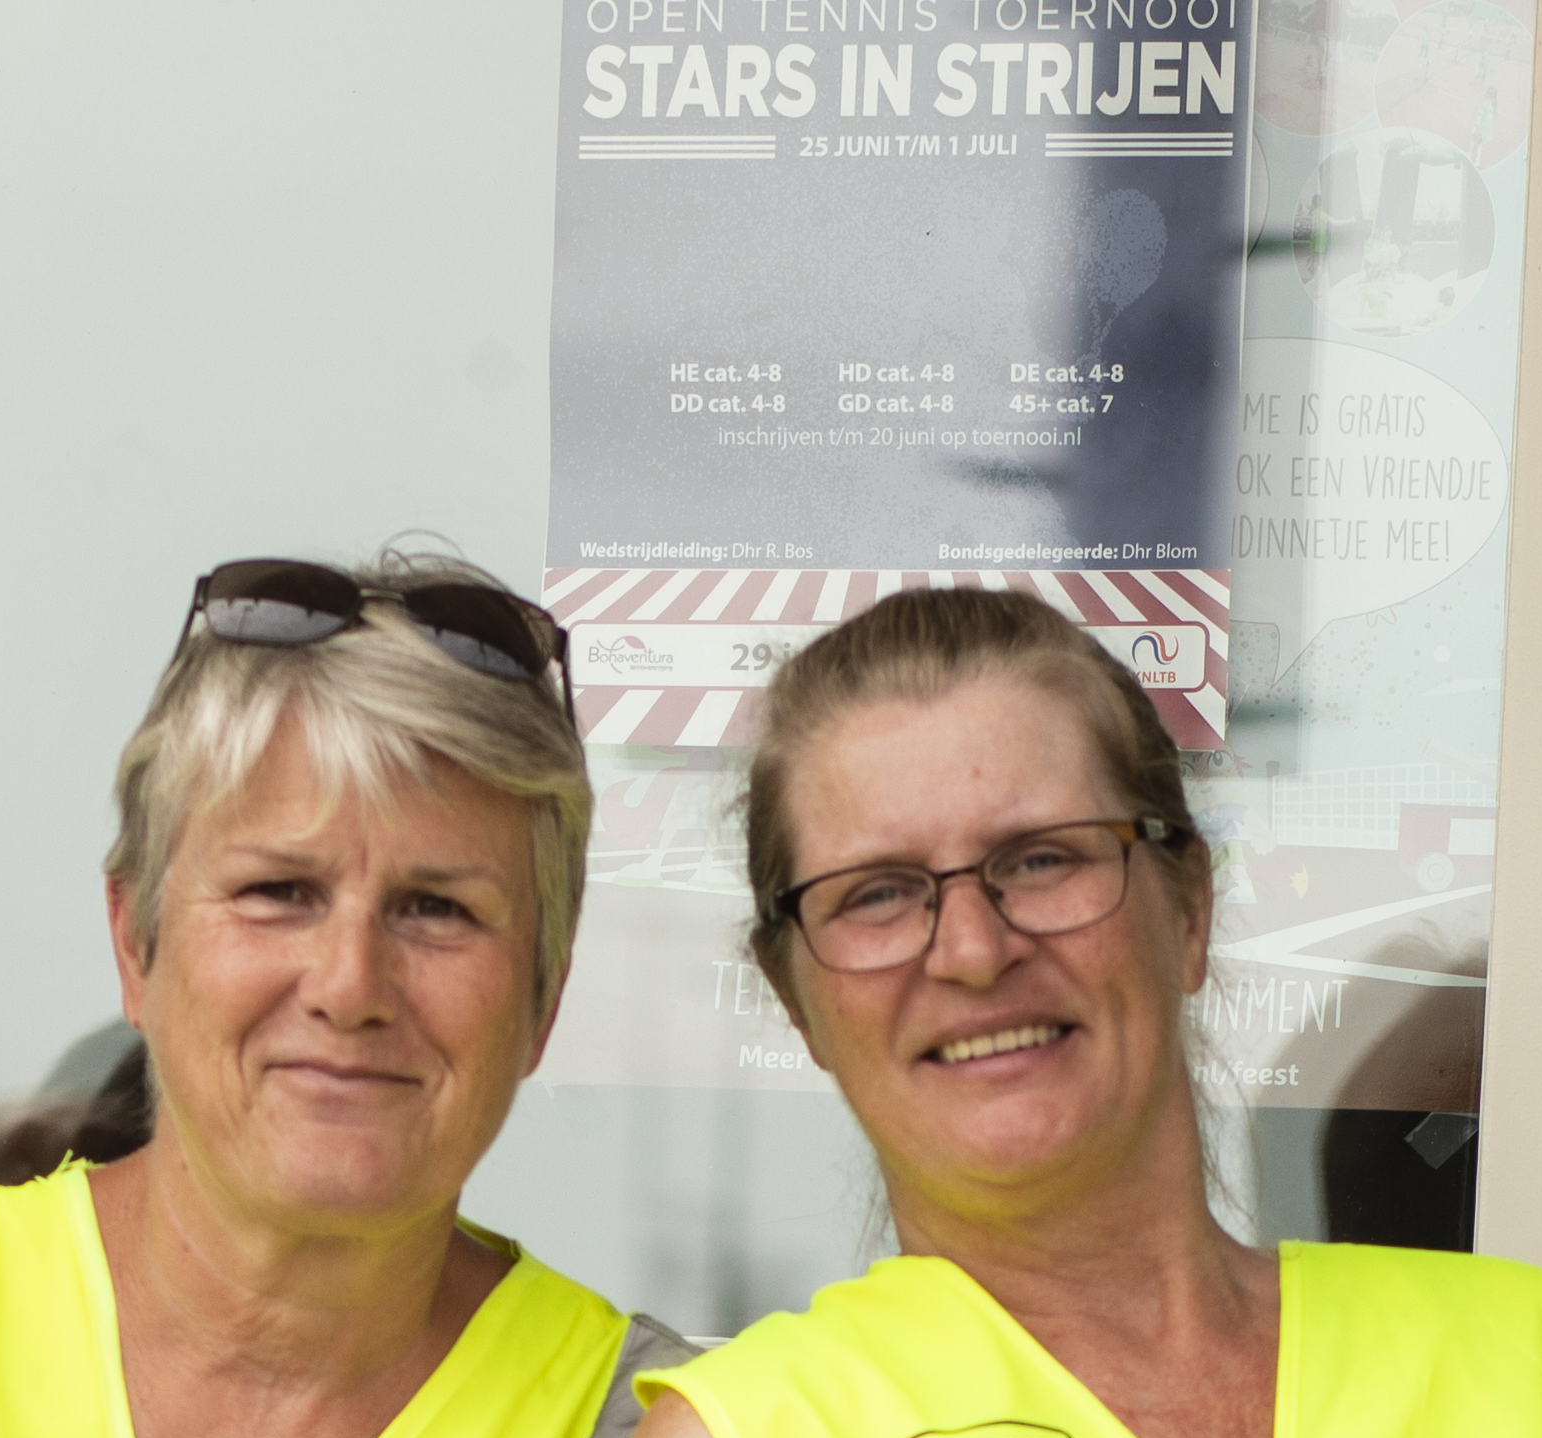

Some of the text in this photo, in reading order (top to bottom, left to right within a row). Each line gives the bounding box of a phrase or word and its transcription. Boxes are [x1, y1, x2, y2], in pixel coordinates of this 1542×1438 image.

[587, 0, 1235, 33] OPEN TENNIS TOERNOOI
[583, 41, 1235, 119] STARS IN STRIJEN
[799, 135, 1018, 157] 25 JUNI T/M 1 JULI
[670, 363, 782, 383] HE cat. 4-8
[838, 363, 955, 383] HD cat. 4-8
[1010, 363, 1124, 383] DE cat. 4-8
[670, 394, 786, 413] DD cat. 4-8
[838, 394, 954, 413] GD cat. 4-8
[1009, 394, 1114, 413] 45+ cat. 7
[1298, 393, 1320, 436] IS
[1338, 393, 1426, 437] GRATIS
[718, 426, 1082, 451] inschrijven t/m 20 juni op toernooi.nl
[1290, 456, 1345, 497] EEN
[1364, 455, 1492, 501] VRIENDJE
[1231, 514, 1451, 562] DINNETJE MEE!
[580, 542, 814, 562] Wedstrijdleiding: Dhr R. Bos
[938, 543, 1197, 563] Bondsgedelegeerde: Dhr Blom
[588, 645, 674, 664] Bonaventura
[730, 643, 772, 671] 29
[1190, 978, 1349, 1033] INMENT
[738, 1044, 808, 1069] Meer
